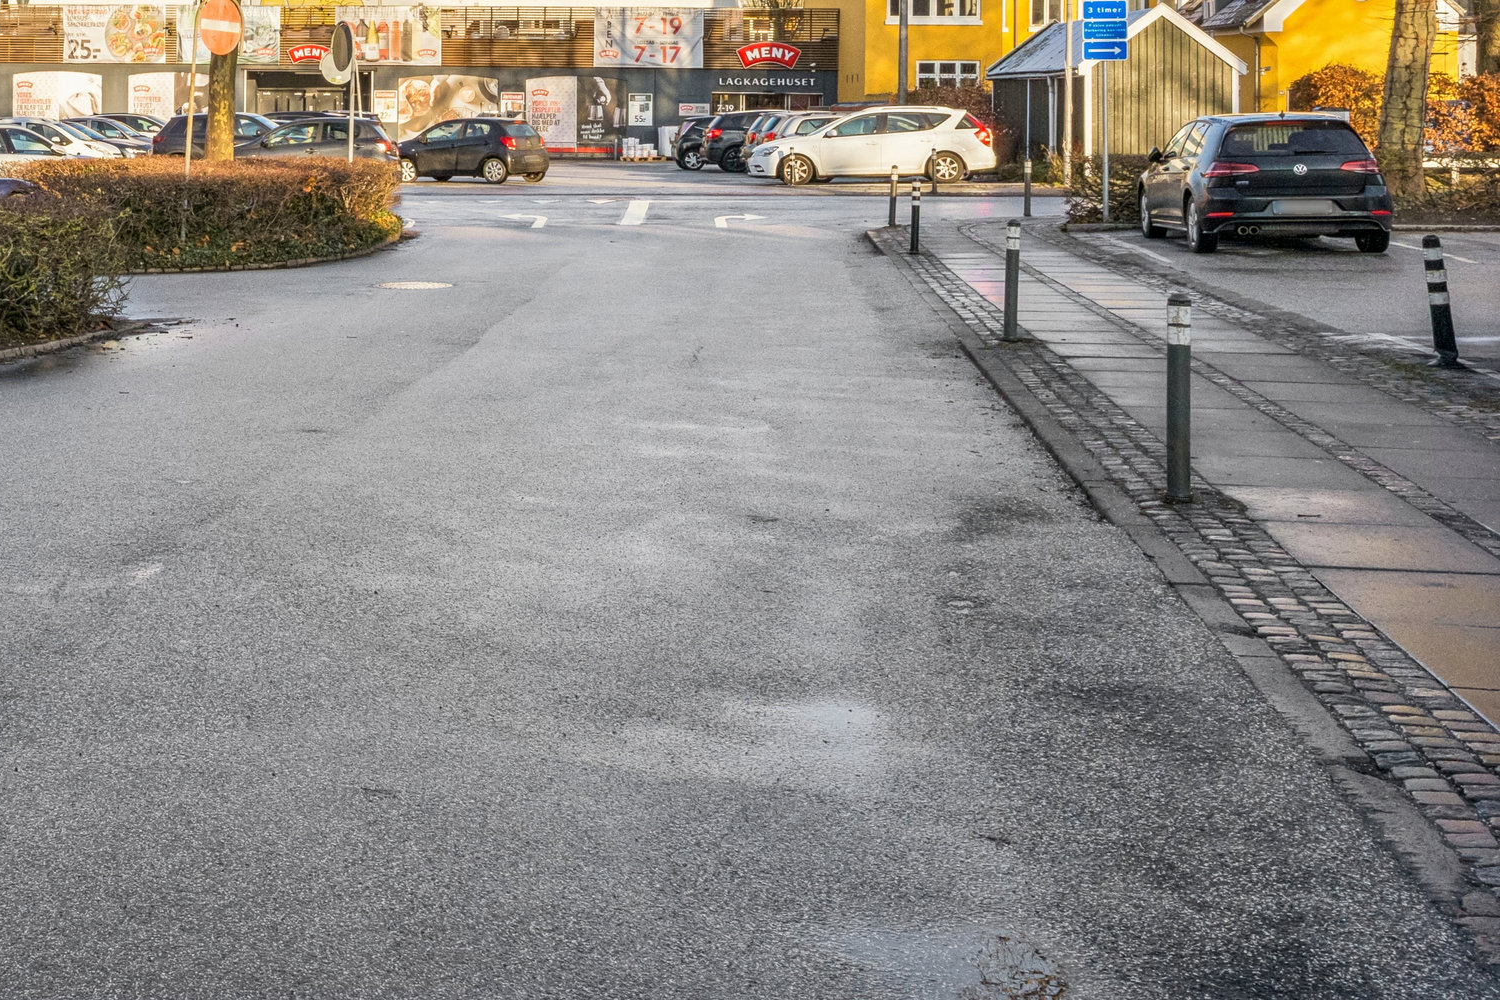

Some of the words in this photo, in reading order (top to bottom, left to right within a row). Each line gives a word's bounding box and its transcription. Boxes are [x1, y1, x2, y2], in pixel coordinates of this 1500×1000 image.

[1087, 6, 1094, 14] 3
[1097, 6, 1122, 14] timer
[661, 16, 683, 35] 19
[661, 46, 682, 63] 17
[745, 47, 795, 61] MENY
[719, 77, 816, 86] LAGKAGEHUSET
[717, 104, 735, 112] 7-19
